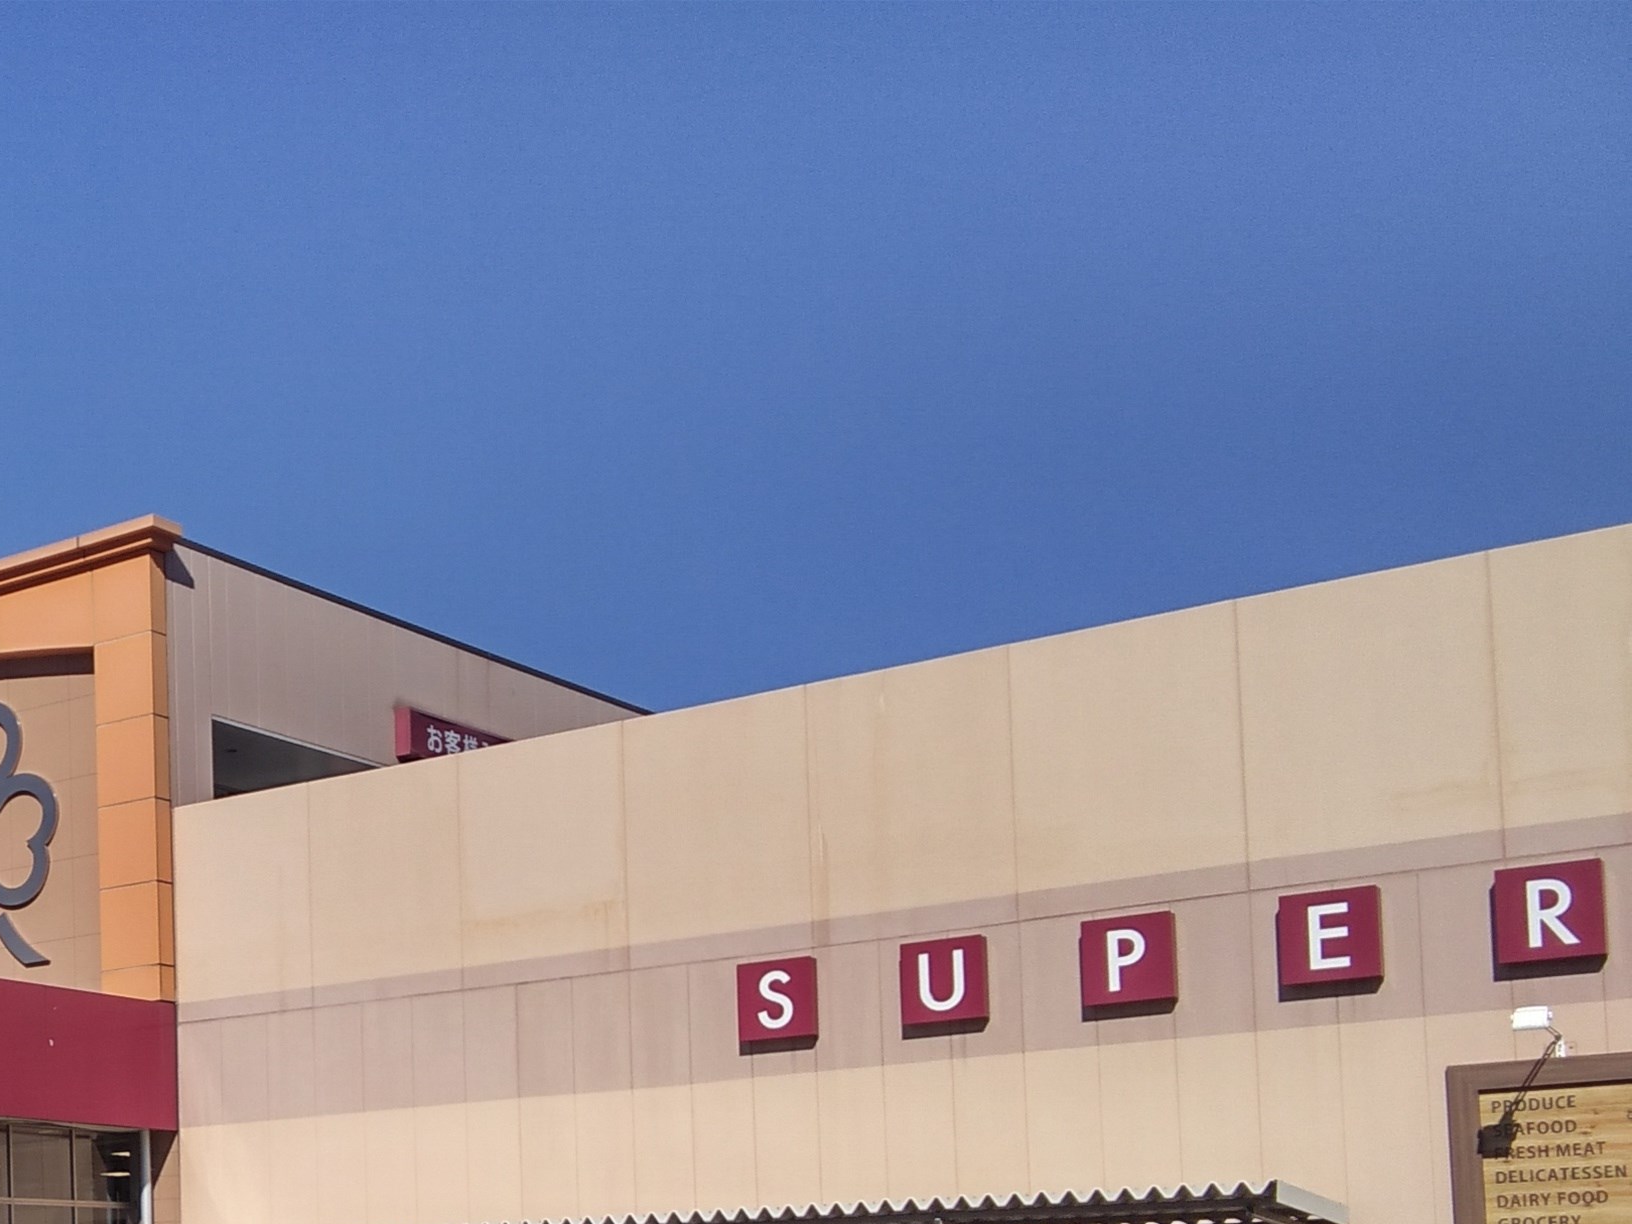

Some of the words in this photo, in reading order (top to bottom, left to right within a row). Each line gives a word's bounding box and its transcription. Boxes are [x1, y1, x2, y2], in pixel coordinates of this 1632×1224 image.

[1490, 1095, 1577, 1114] PRODUCE
[1494, 1119, 1578, 1137] SEAFOOD
[1495, 1144, 1550, 1160] FRESH
[1555, 1141, 1606, 1158] MEAT
[1495, 1165, 1628, 1184] DELICATESSEN
[1496, 1192, 1551, 1208] DAIRY
[1557, 1190, 1609, 1206] FOOD
